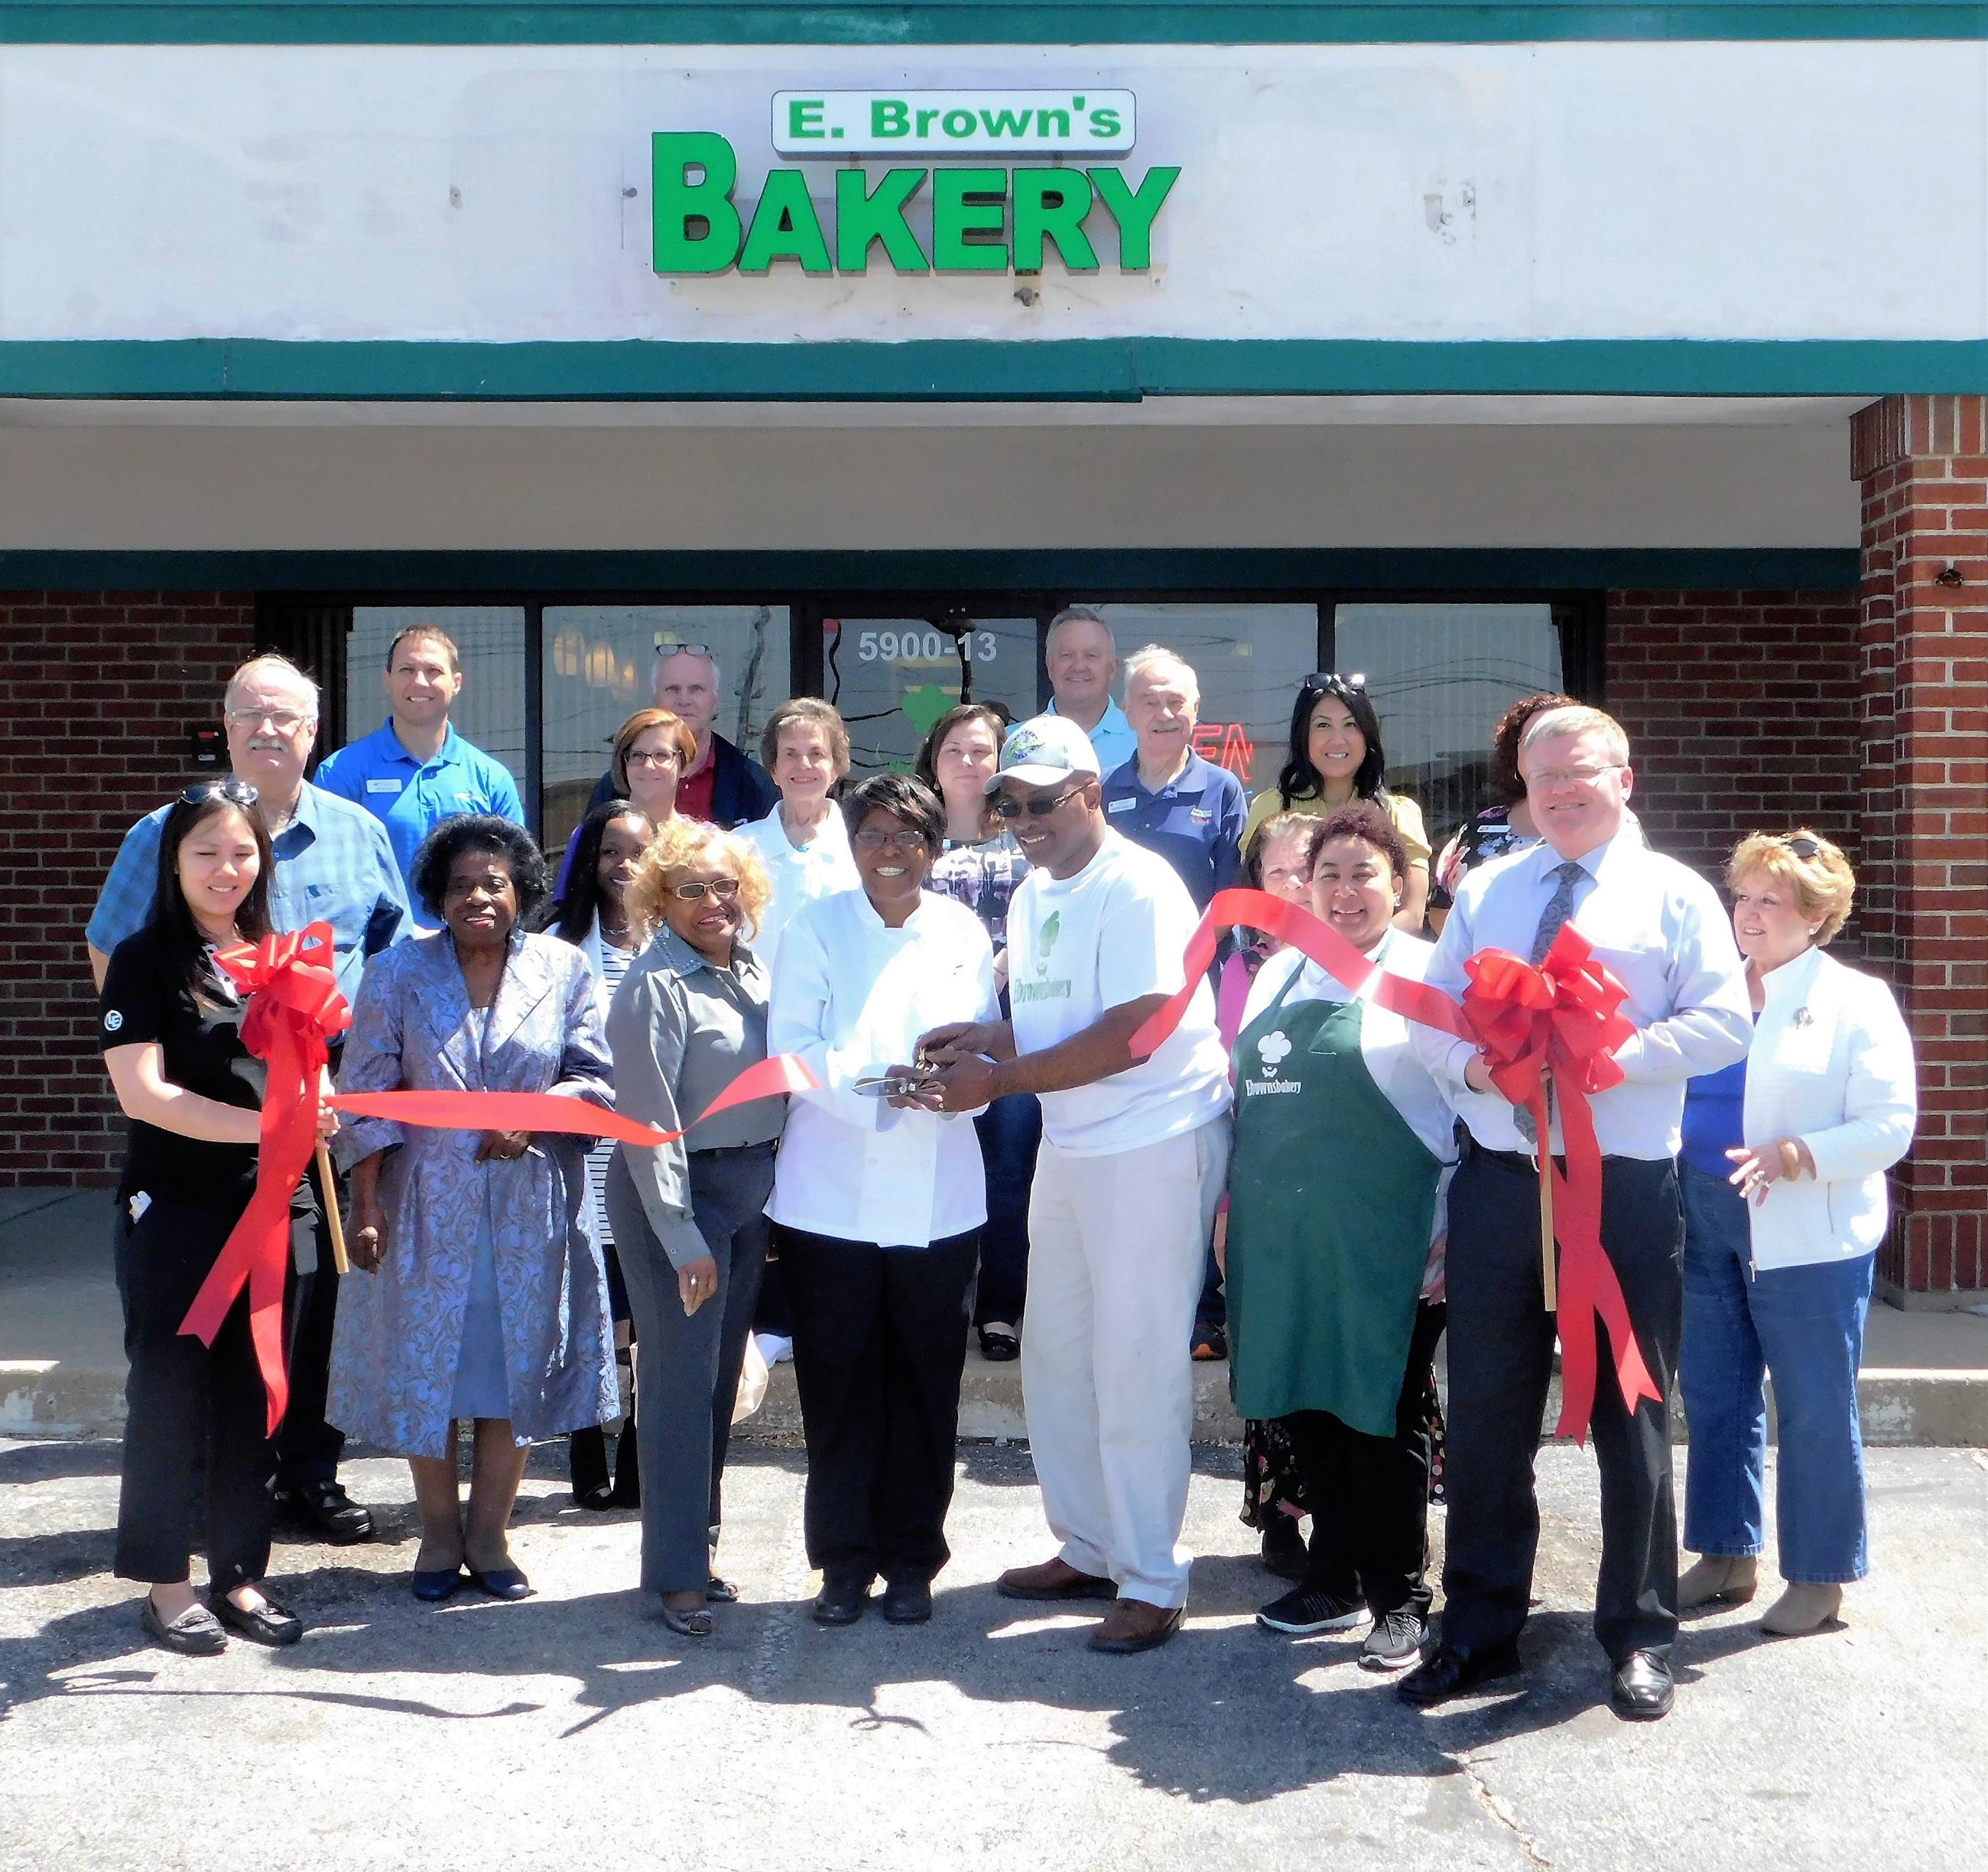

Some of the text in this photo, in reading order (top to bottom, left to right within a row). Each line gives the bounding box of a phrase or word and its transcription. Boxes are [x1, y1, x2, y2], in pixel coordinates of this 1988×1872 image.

[788, 96, 1122, 138] E. Brown's
[651, 131, 1182, 274] BAKERY
[858, 631, 998, 662] 5900-13
[1192, 723, 1253, 780] EN
